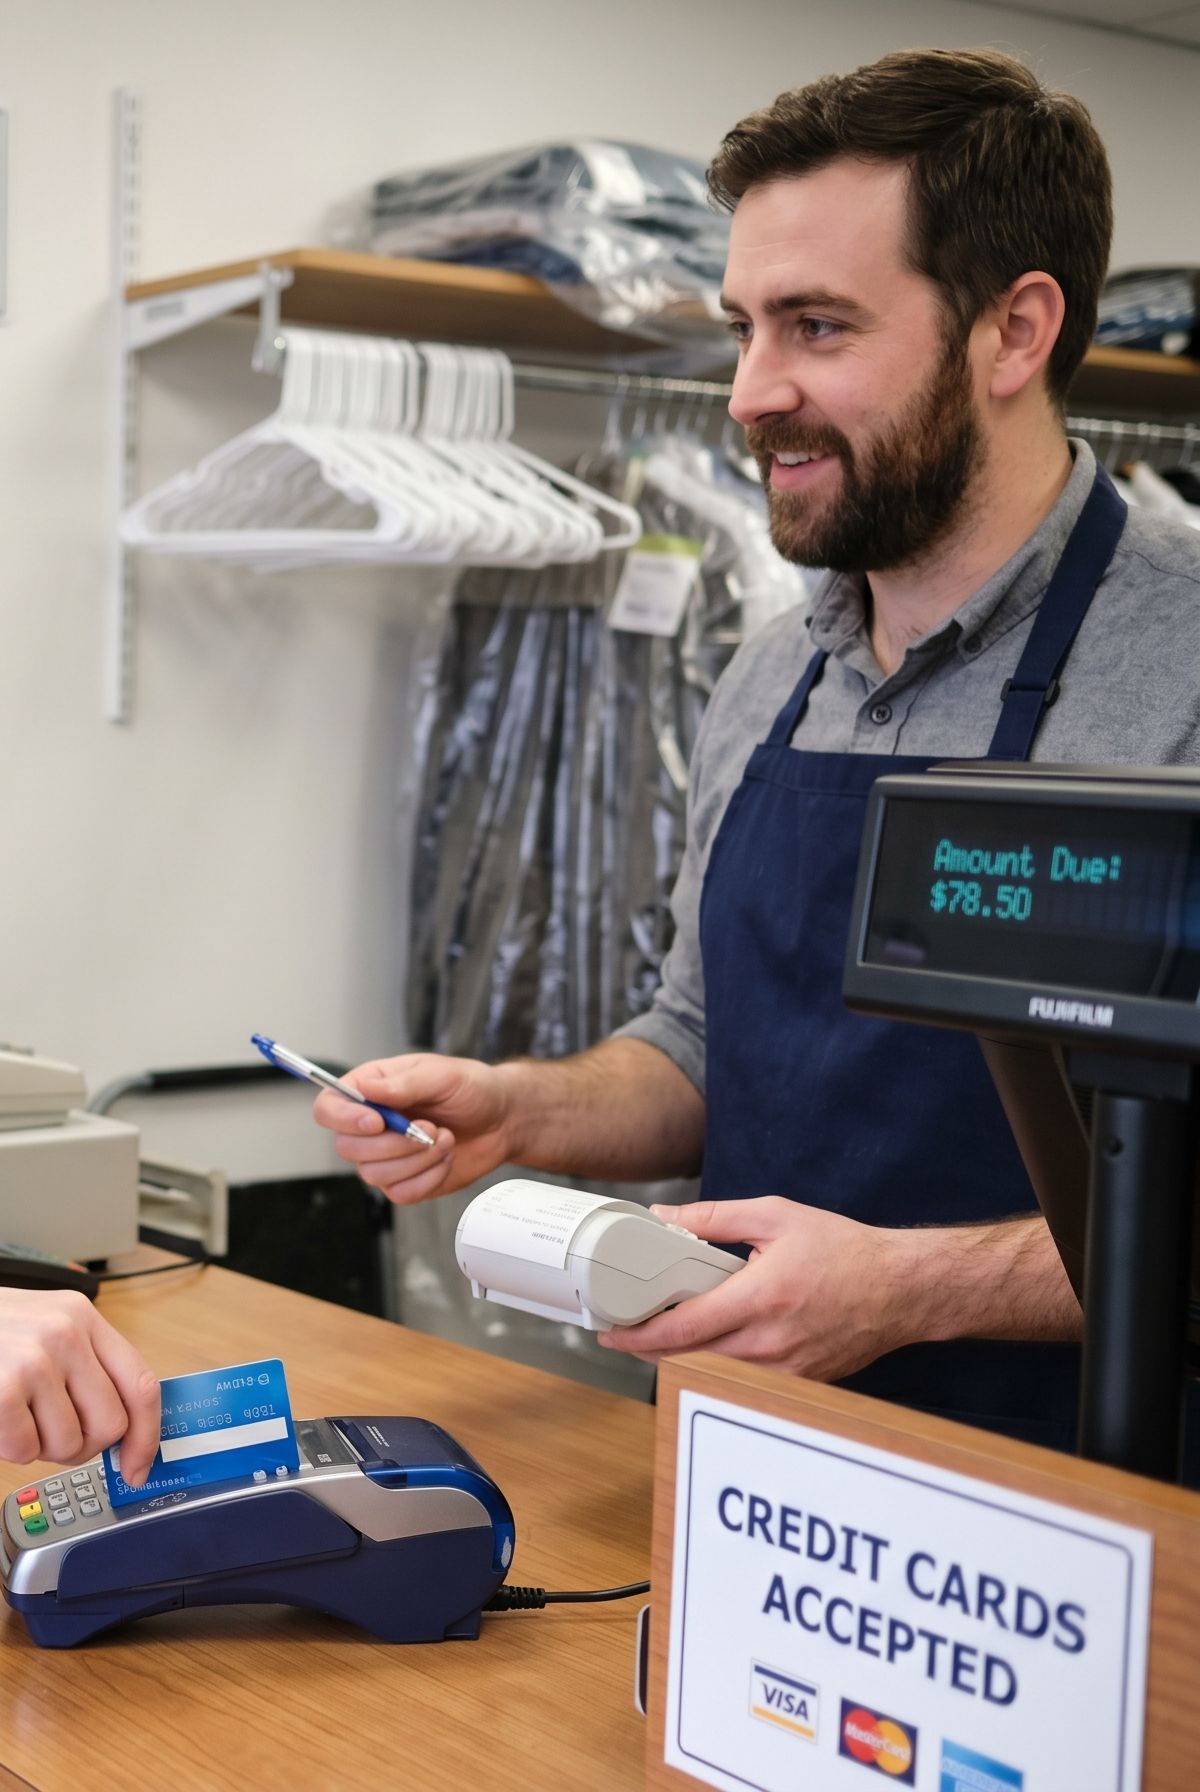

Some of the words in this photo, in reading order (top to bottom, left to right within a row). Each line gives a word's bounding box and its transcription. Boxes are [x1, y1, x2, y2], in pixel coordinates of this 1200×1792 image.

[933, 838, 1036, 879] Amount
[1050, 846, 1121, 884] Due:
[930, 879, 1032, 920] $78.50
[717, 1487, 890, 1583] CREDIT
[906, 1551, 1087, 1656] CARDS
[762, 1574, 1019, 1708] ACCEPTED
[761, 1682, 810, 1721] VISA
